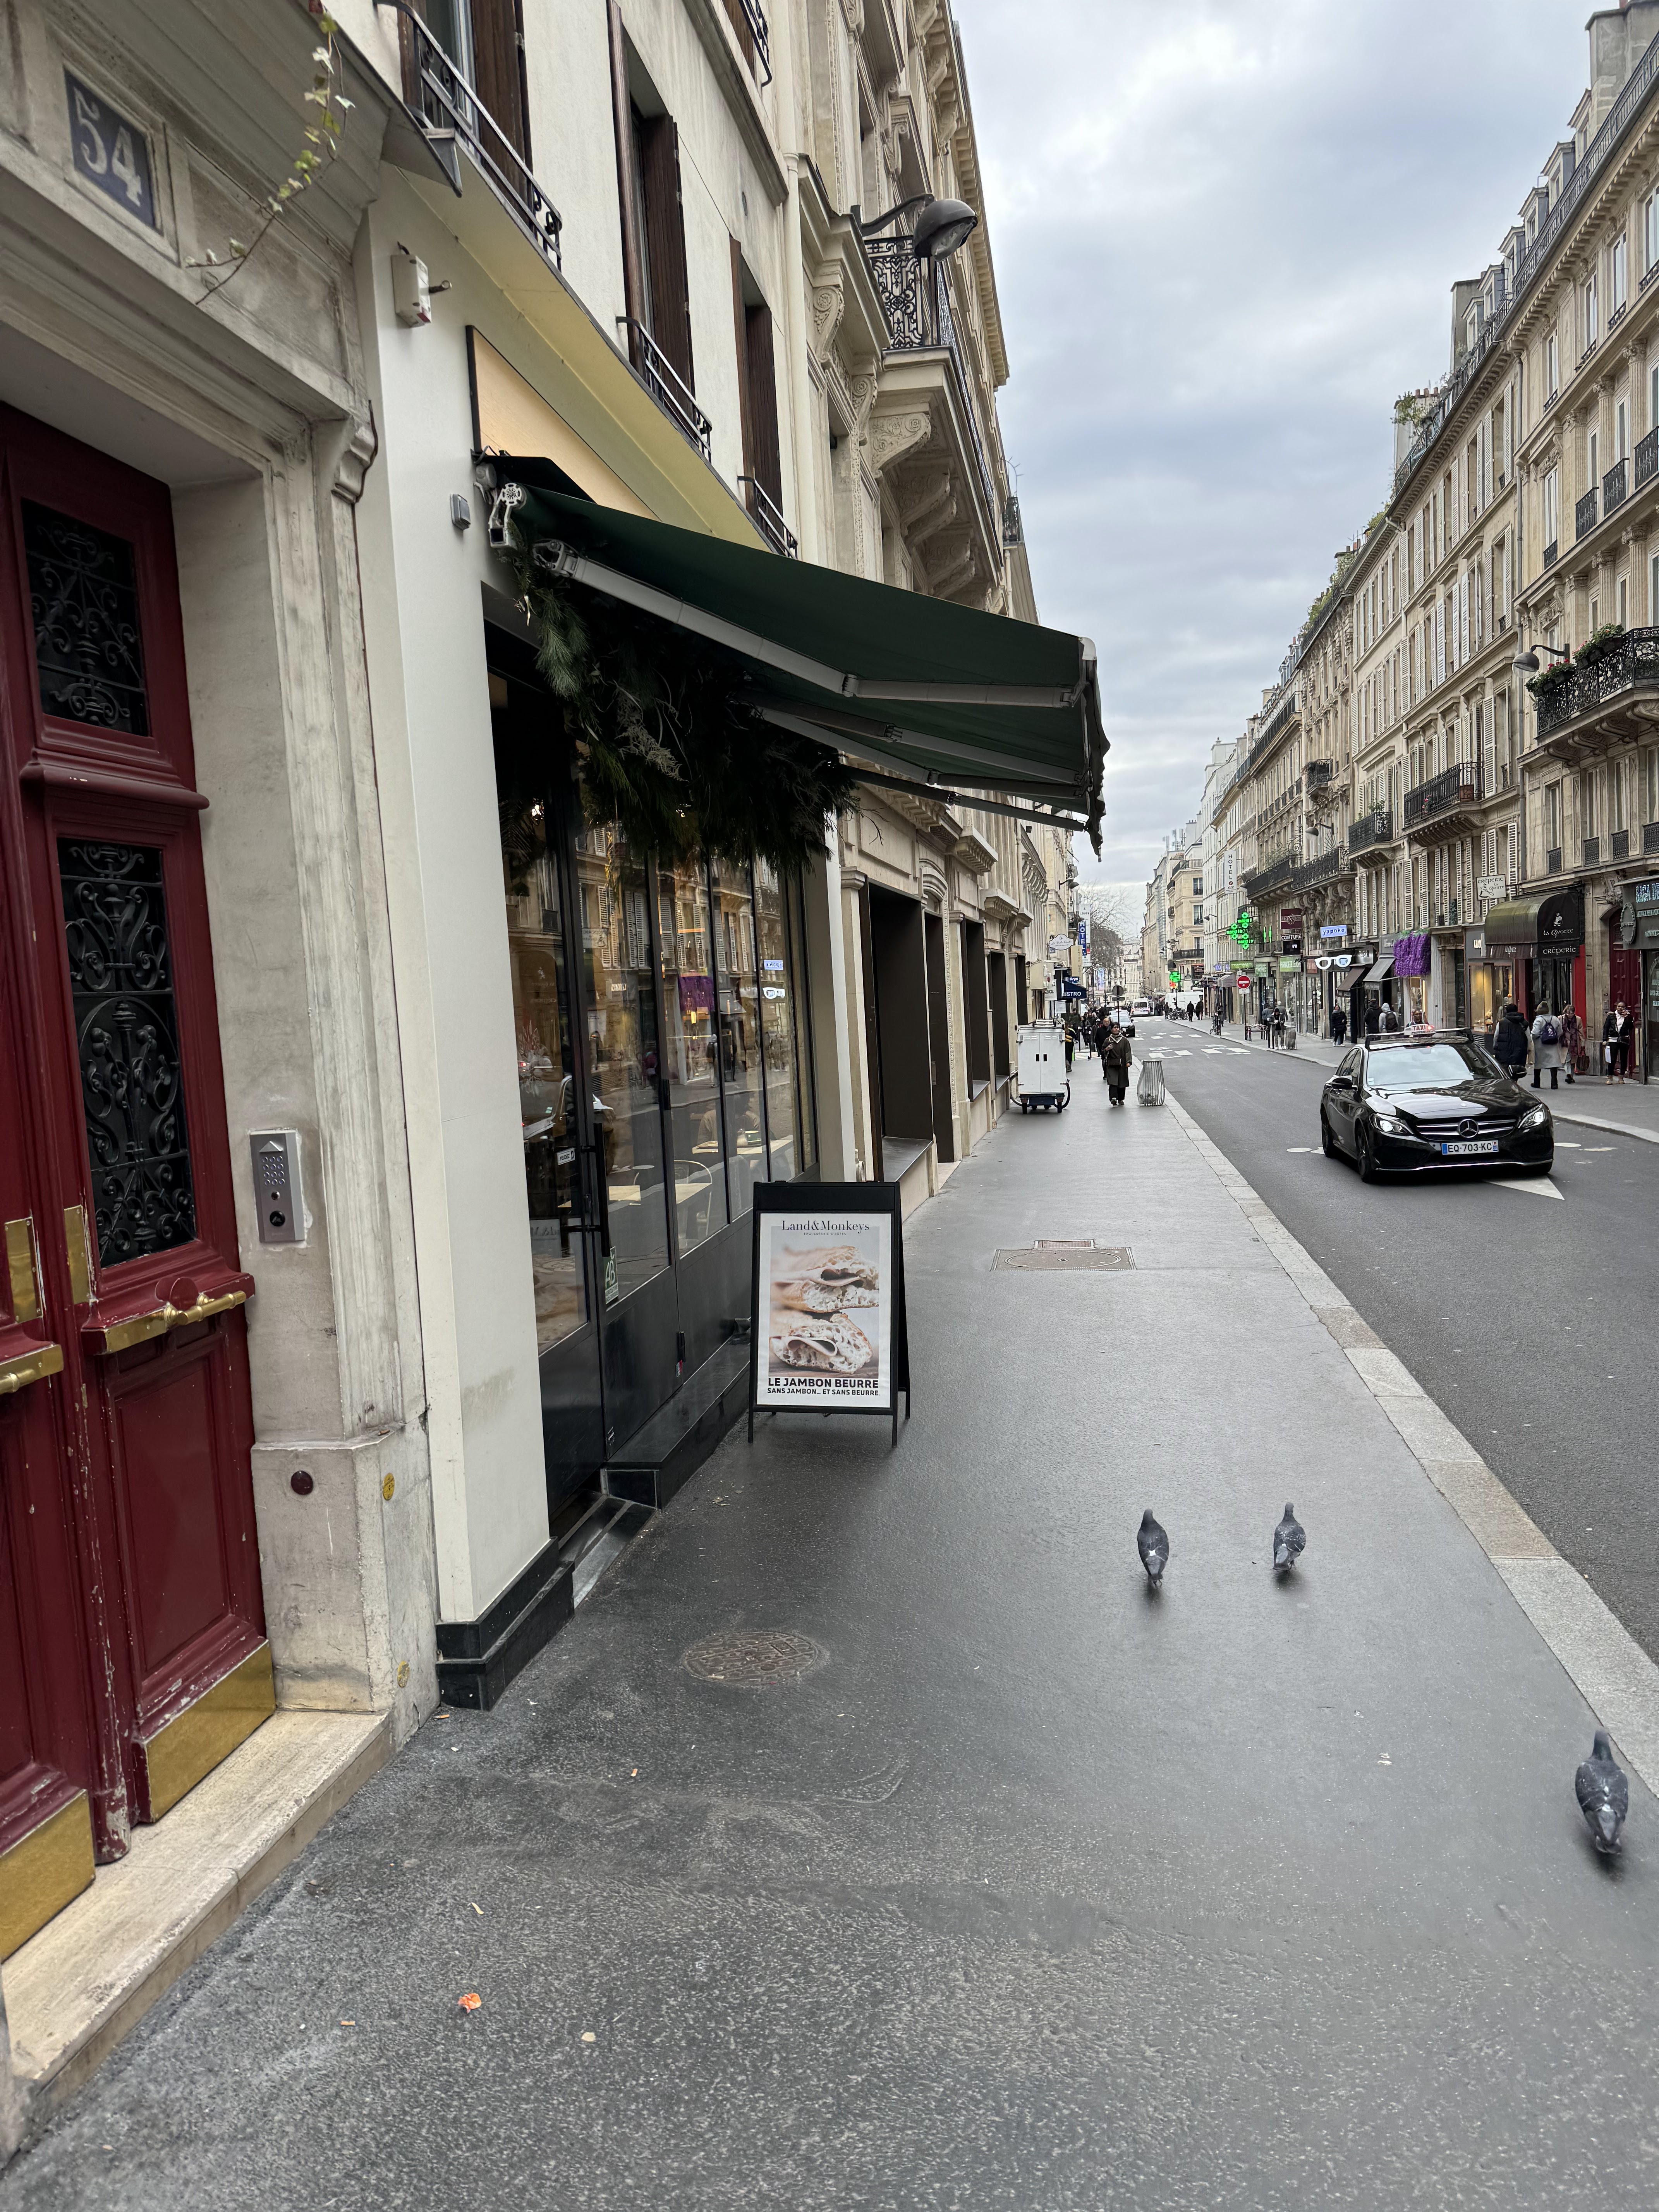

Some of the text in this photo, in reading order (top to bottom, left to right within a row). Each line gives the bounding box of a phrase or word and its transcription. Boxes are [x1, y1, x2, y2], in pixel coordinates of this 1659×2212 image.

[73, 86, 142, 207] 54
[1448, 1143, 1492, 1152] EQ-703-KC
[782, 1220, 869, 1233] Land&Monkeys
[606, 1260, 615, 1289] AB
[768, 1378, 879, 1388] LE JAMBON BEURRE
